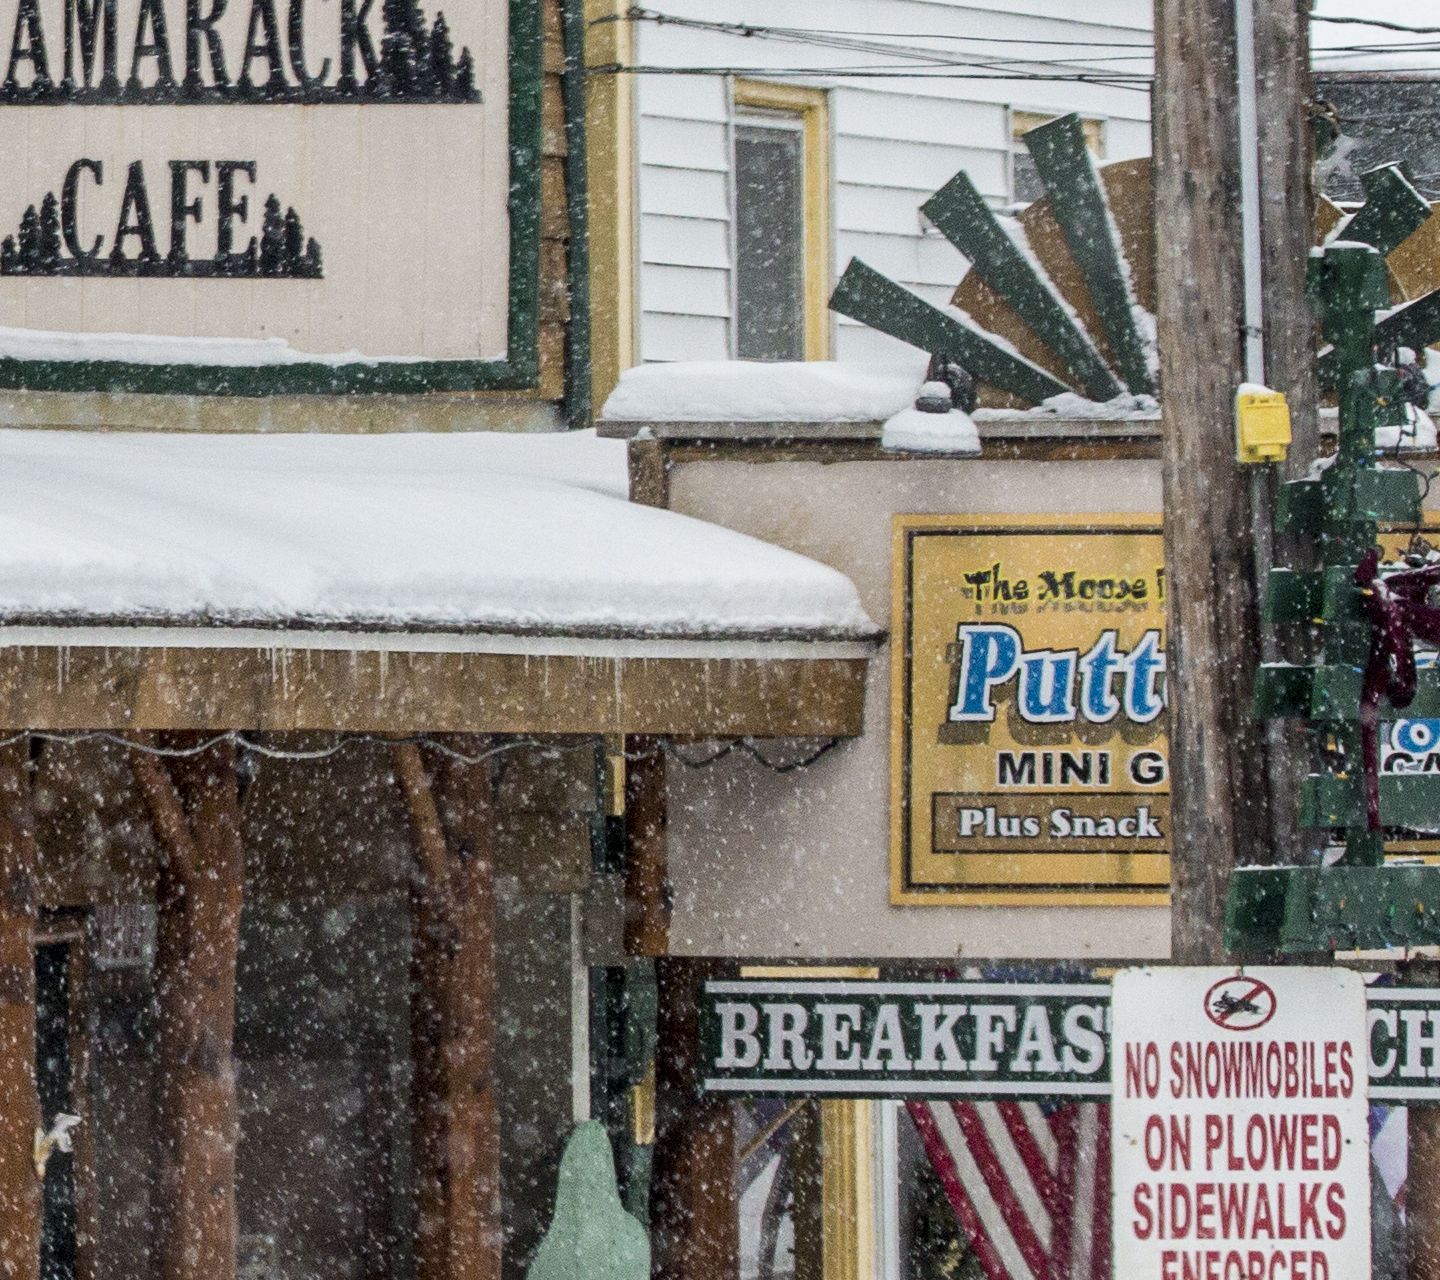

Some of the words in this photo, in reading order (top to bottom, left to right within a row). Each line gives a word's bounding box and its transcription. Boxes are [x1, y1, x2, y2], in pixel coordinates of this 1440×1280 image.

[60, 158, 258, 262] CAFE
[964, 562, 1029, 602] The
[1037, 570, 1149, 602] Moose
[949, 621, 1168, 724] Putt
[997, 751, 1111, 786] MINI
[958, 806, 1041, 838] Plus
[1049, 805, 1165, 839] Snack
[715, 1002, 1112, 1075] BREAKFAS
[1125, 1040, 1161, 1100] NO
[1170, 1040, 1355, 1100] SNOWMOBILES
[1144, 1113, 1191, 1172] ON
[1205, 1113, 1343, 1172] PLOWED
[1132, 1181, 1348, 1241] SIDEWALKS
